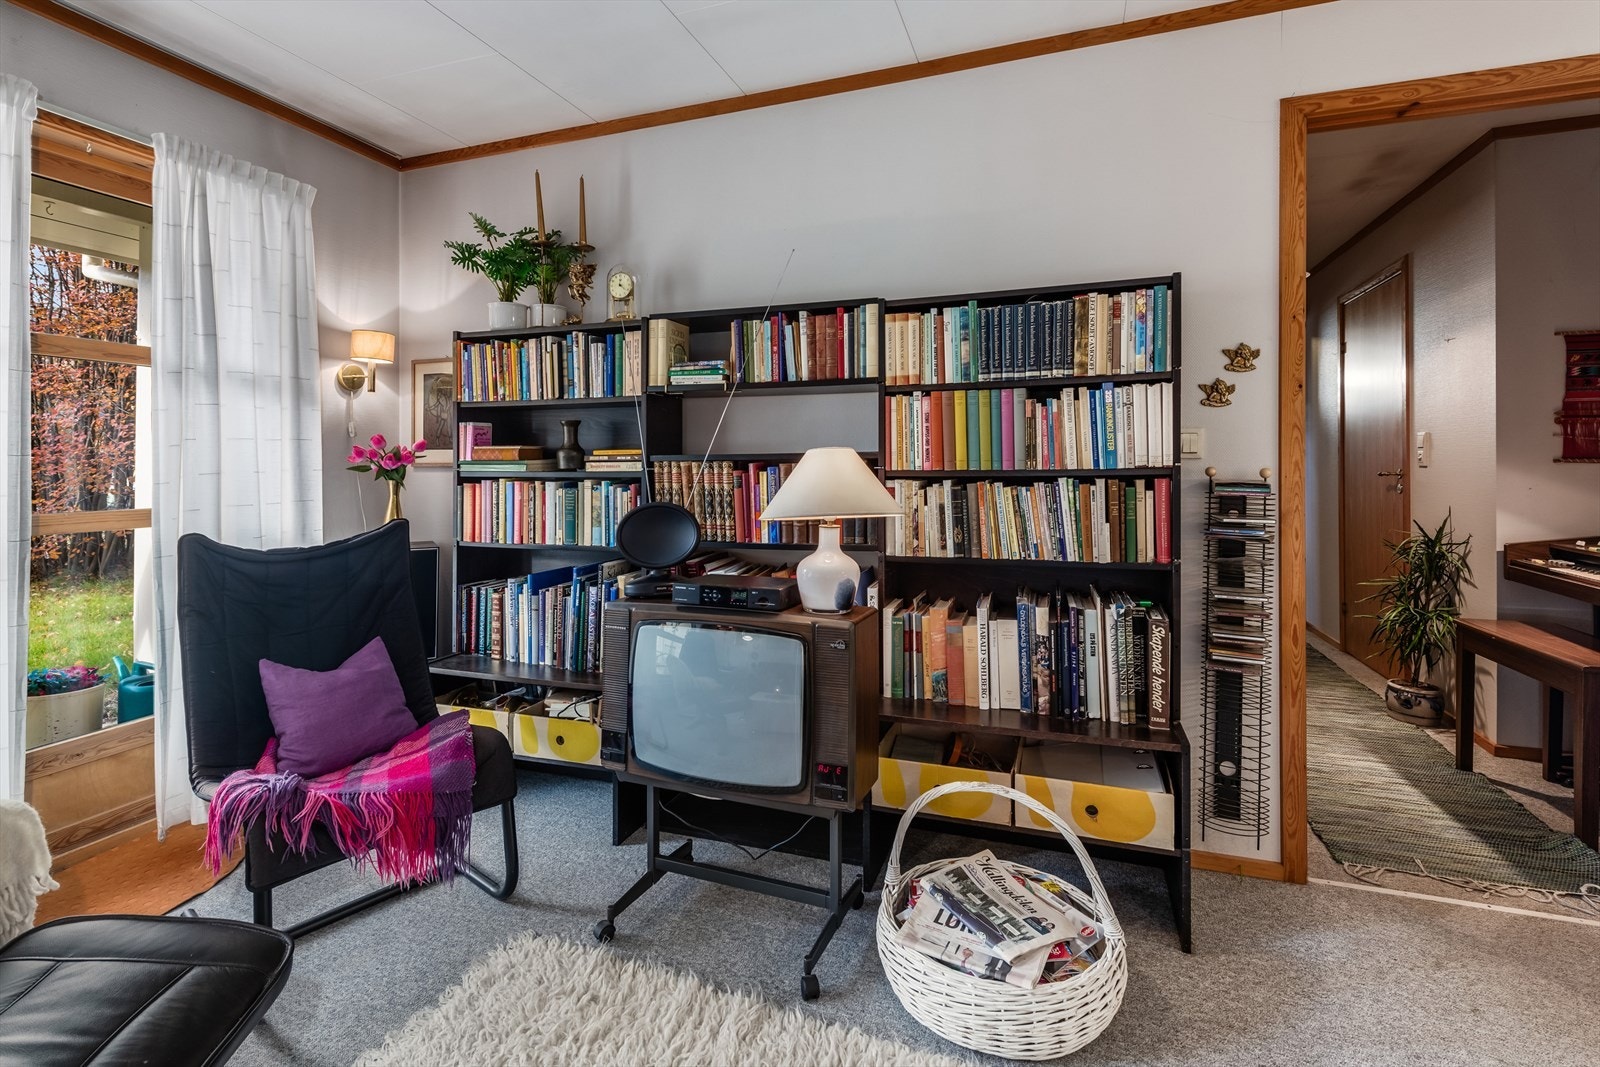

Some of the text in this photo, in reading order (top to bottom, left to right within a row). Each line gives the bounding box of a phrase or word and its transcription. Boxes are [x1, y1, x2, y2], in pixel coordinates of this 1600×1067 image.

[1106, 403, 1115, 451] RANKINGLISTER
[1109, 623, 1118, 675] SCANDINAVIA
[1117, 616, 1128, 696] VERDENSKUNSTEN
[1125, 616, 1135, 696] VERDENSKUNSTEN
[1133, 634, 1142, 692] MODERN ART
[1149, 624, 1166, 675] Skapende
[980, 657, 988, 699] SOHLBERG
[1152, 675, 1166, 713] hender
[975, 856, 1037, 914] Hallingdølen
